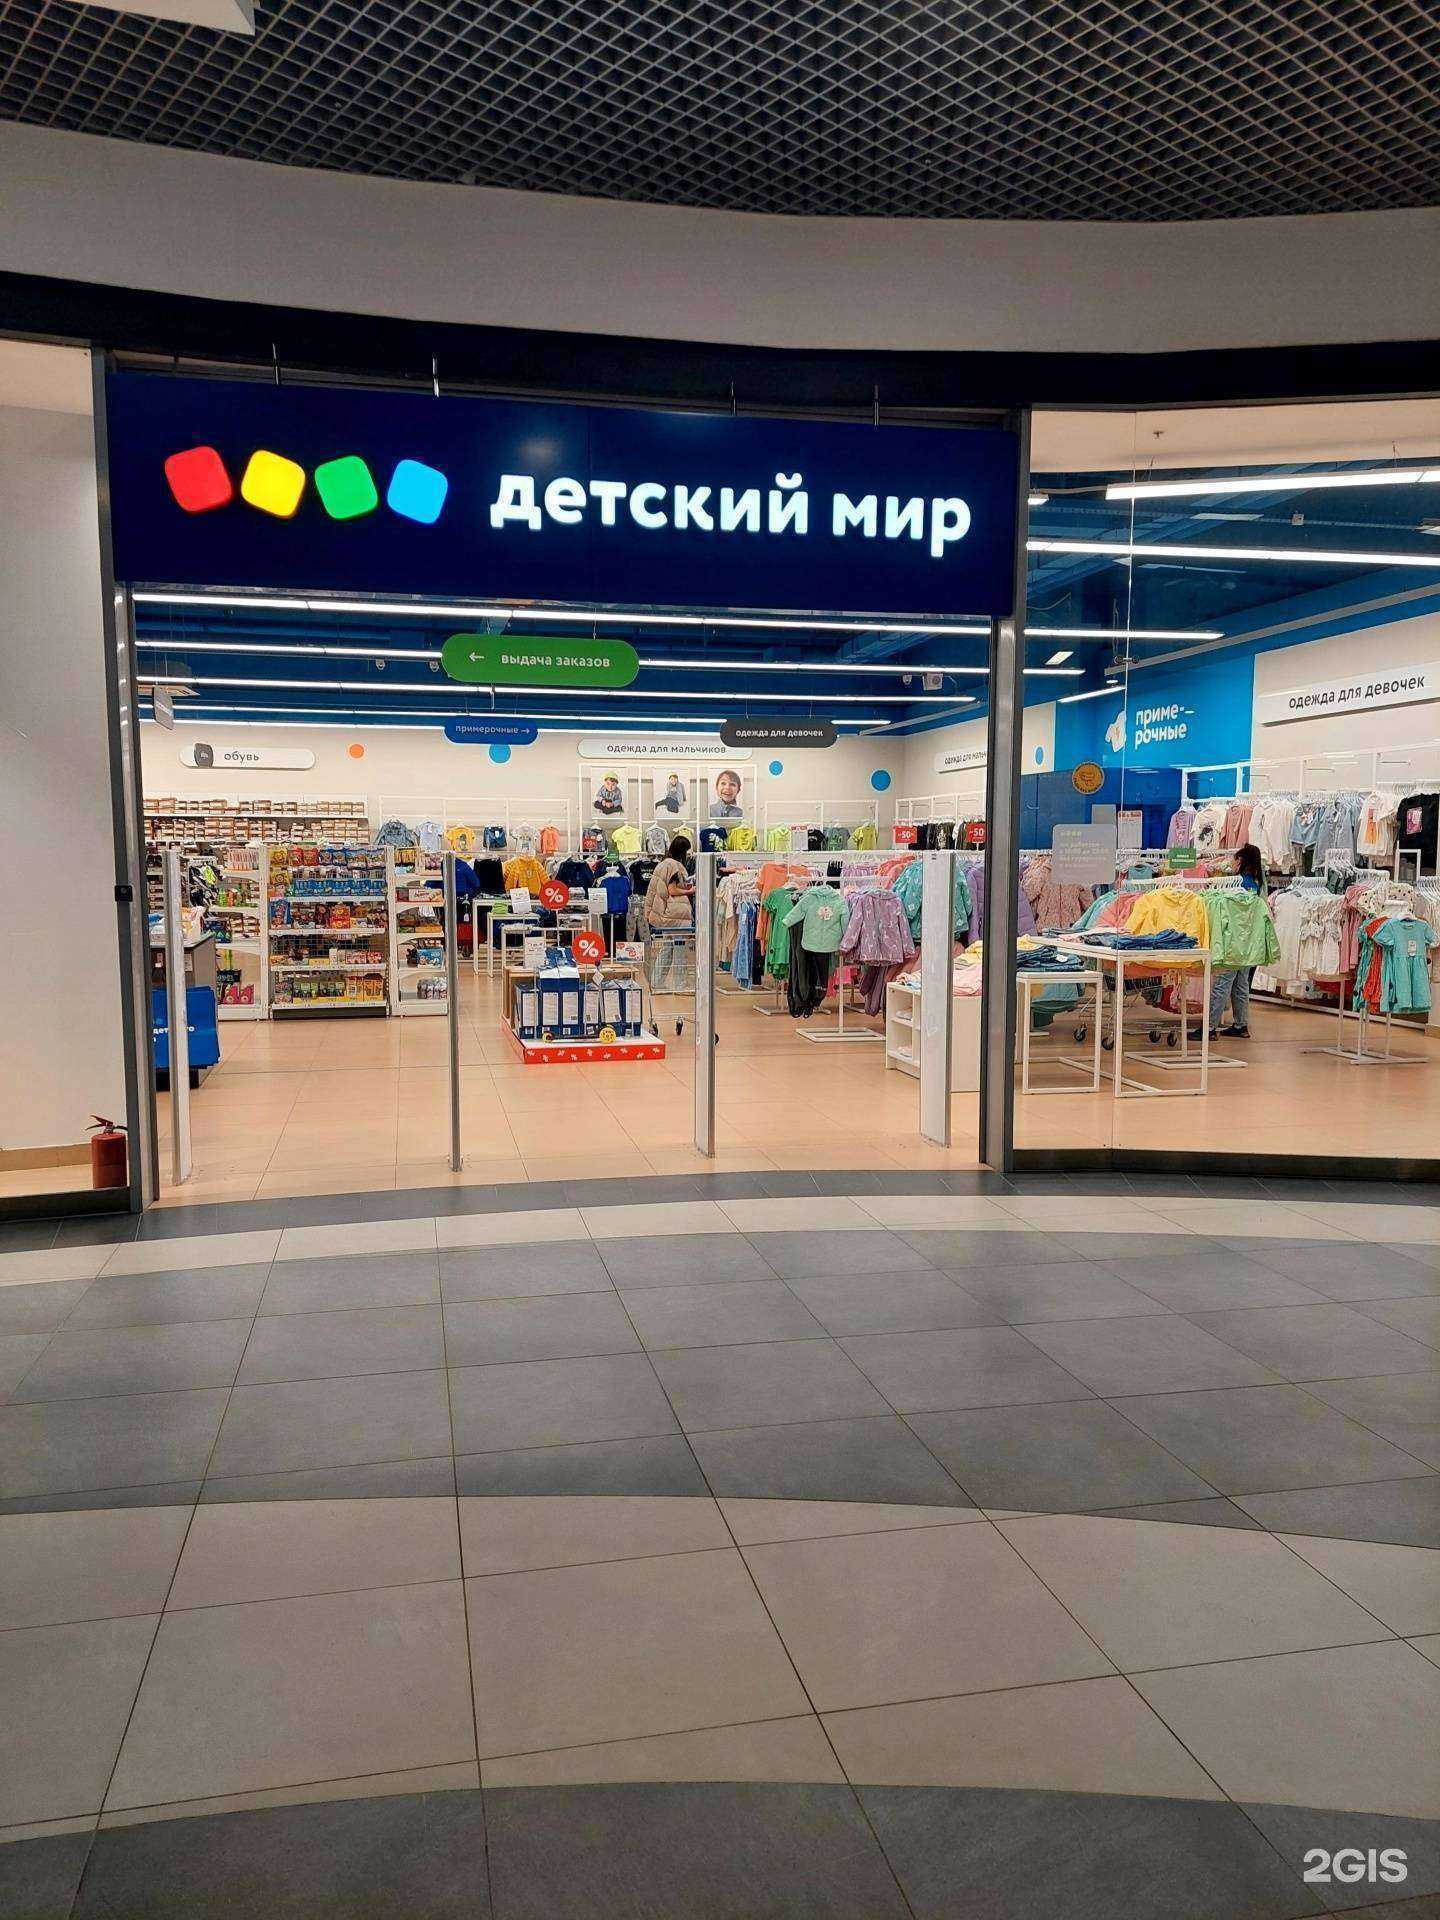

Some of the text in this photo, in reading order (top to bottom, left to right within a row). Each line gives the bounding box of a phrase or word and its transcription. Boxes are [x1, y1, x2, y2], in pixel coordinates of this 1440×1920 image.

[489, 472, 972, 558] детский мир
[501, 654, 610, 668] выдача заказов
[1288, 675, 1425, 710] одежда для девочек
[455, 725, 519, 735] примерочные
[735, 729, 824, 738] одежда для девочек
[1134, 723, 1187, 750] рочные
[606, 744, 726, 754] одежда для мальчиков
[224, 750, 260, 763] обувь
